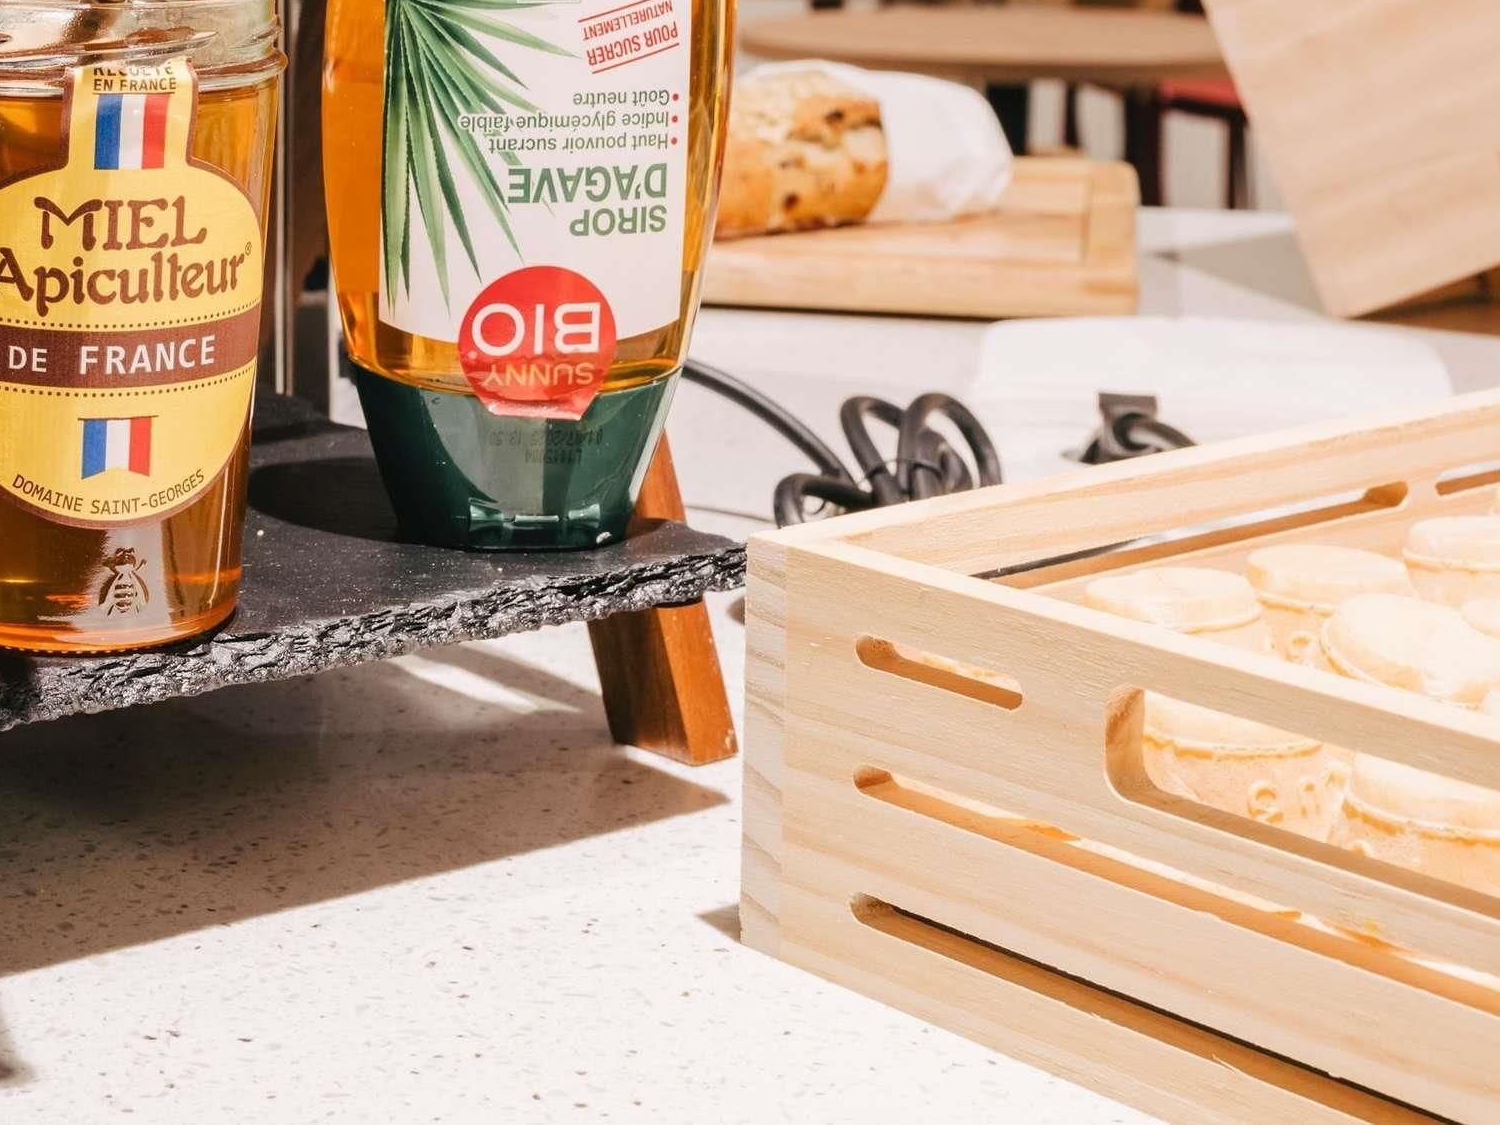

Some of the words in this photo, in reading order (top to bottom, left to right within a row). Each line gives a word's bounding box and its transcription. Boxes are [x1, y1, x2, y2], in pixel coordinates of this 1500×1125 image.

[582, 0, 673, 41] NATURELLEMENT
[643, 21, 679, 48] POUR
[586, 35, 641, 67] SUCRER
[93, 78, 113, 92] EN
[120, 77, 177, 92] FRANCE
[572, 91, 627, 107] neutre
[633, 90, 670, 108] Goût
[460, 115, 510, 133] faible
[515, 111, 616, 133] glycémique
[622, 111, 669, 128] Indice
[488, 137, 557, 154] sucrant
[562, 132, 627, 154] pouvoir
[632, 133, 669, 149] Haut
[508, 162, 668, 204] D'AGAVE
[34, 195, 208, 252] MIEL
[569, 205, 667, 237] SIROP
[471, 301, 600, 357] BIO
[7, 345, 49, 374] DE
[80, 334, 217, 376] FRANCE
[481, 362, 595, 388] SUNNY
[11, 473, 83, 514] DOMAINE
[90, 468, 206, 516] SAINT-GEORGES
